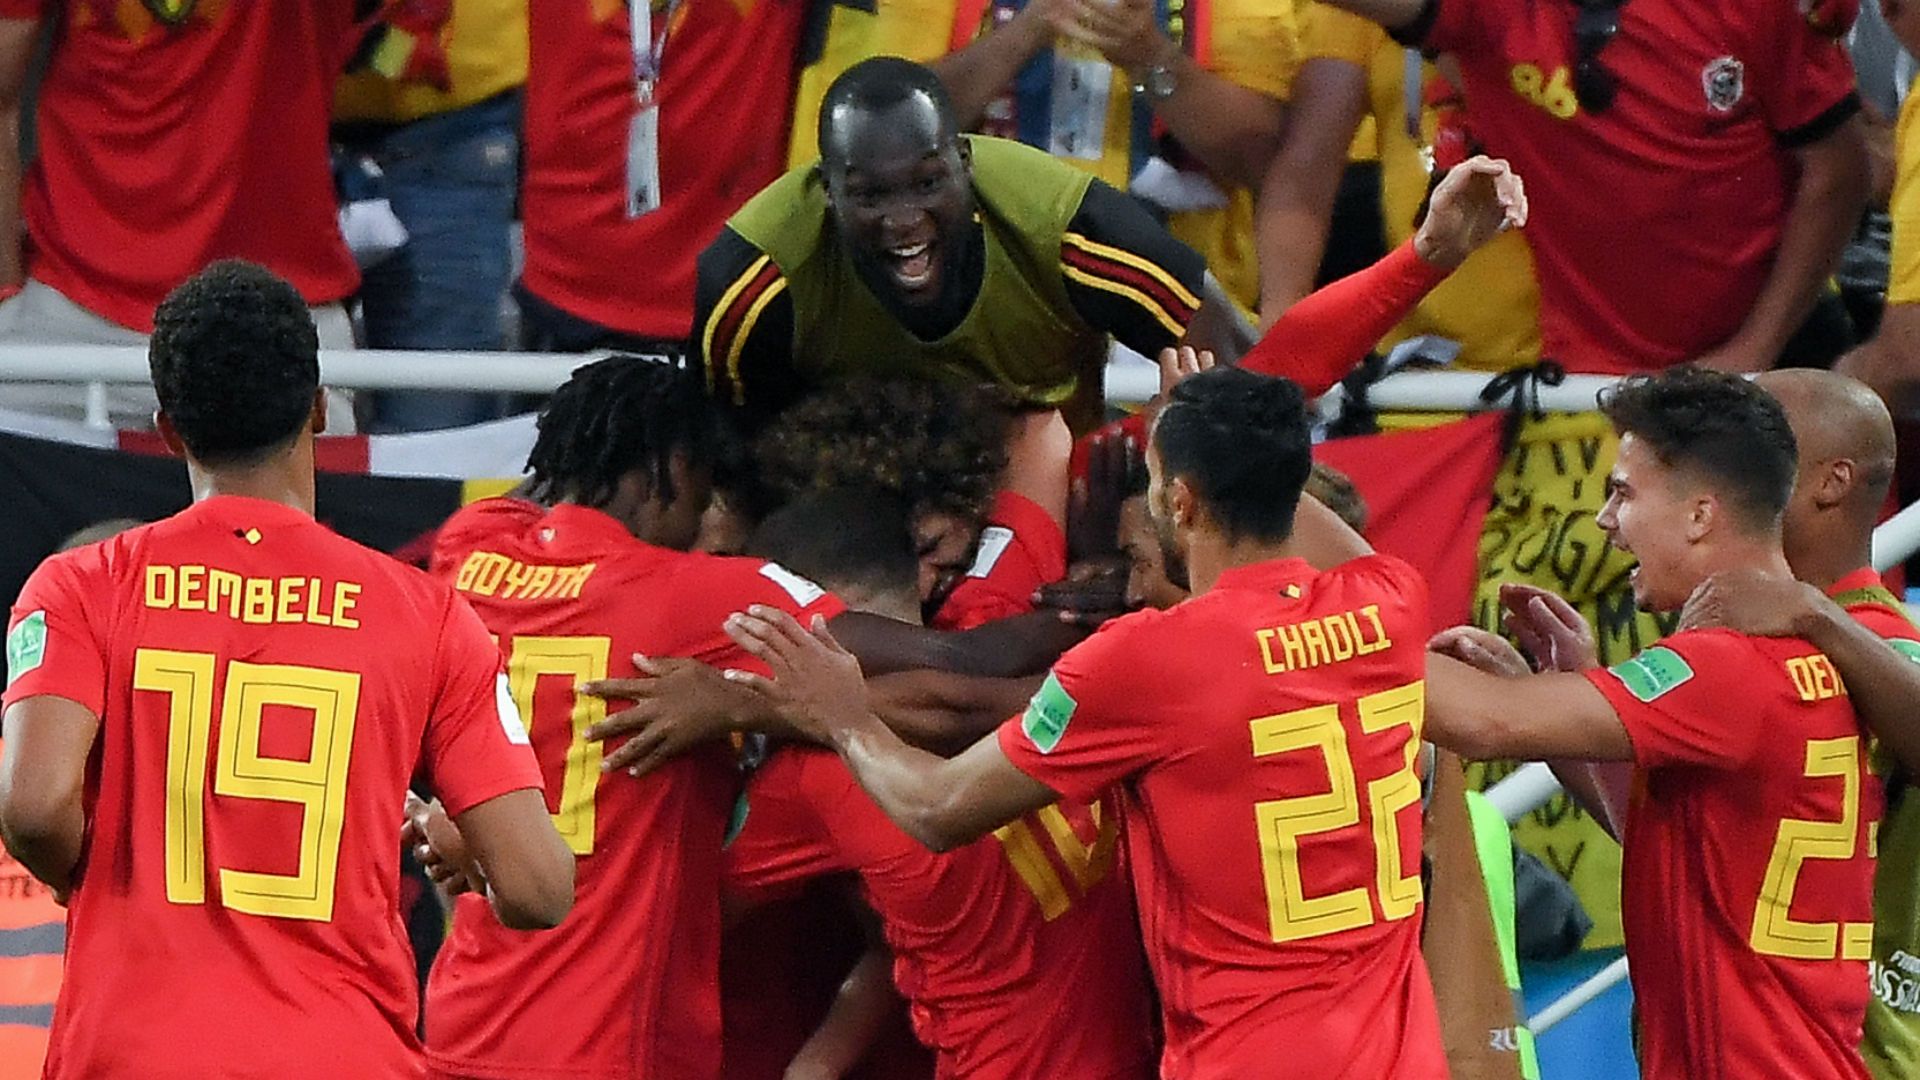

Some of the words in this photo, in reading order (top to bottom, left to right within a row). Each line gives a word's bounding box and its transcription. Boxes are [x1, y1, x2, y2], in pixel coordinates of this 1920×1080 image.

[143, 564, 363, 630] DEMBELE
[455, 550, 597, 600] BOYATA
[1255, 603, 1393, 675] CHADLI
[132, 647, 362, 923] 19
[491, 634, 612, 855] 0
[1249, 679, 1426, 944] 22
[1749, 735, 1879, 961] 2
